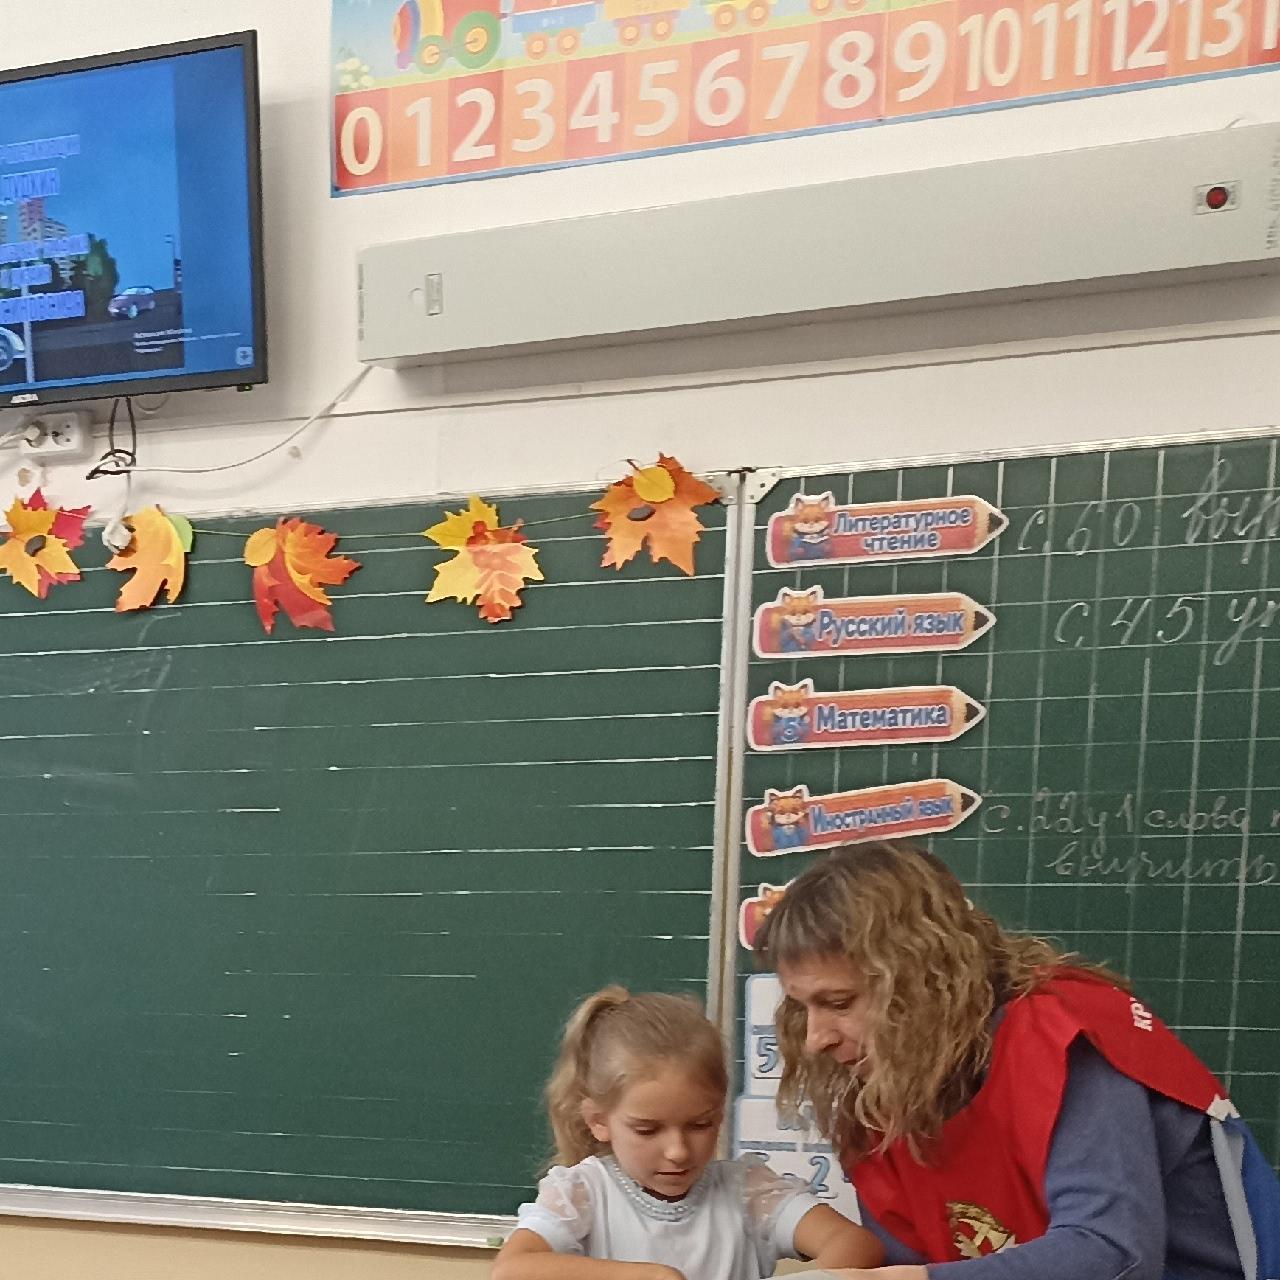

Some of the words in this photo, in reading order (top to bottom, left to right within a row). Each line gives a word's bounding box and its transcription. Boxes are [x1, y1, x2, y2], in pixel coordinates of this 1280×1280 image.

[340, 107, 383, 175] 0
[405, 97, 432, 166] 1
[453, 88, 496, 161] 2
[512, 79, 555, 153] 3
[569, 70, 619, 143] 4
[634, 60, 680, 137] 5
[694, 49, 746, 127] 6
[761, 42, 810, 120] 7
[824, 31, 876, 109] 8
[894, 21, 946, 102] 9
[959, 8, 1018, 91] 10
[1032, 2, 1091, 80] 11
[1103, 0, 1168, 71] 12
[1178, 0, 1245, 61] 13
[834, 508, 970, 535] Литературное
[864, 532, 938, 551] чтение
[817, 608, 906, 647] Русский
[913, 612, 965, 634] язык
[1111, 597, 1210, 645] 45
[817, 704, 947, 732] Математика
